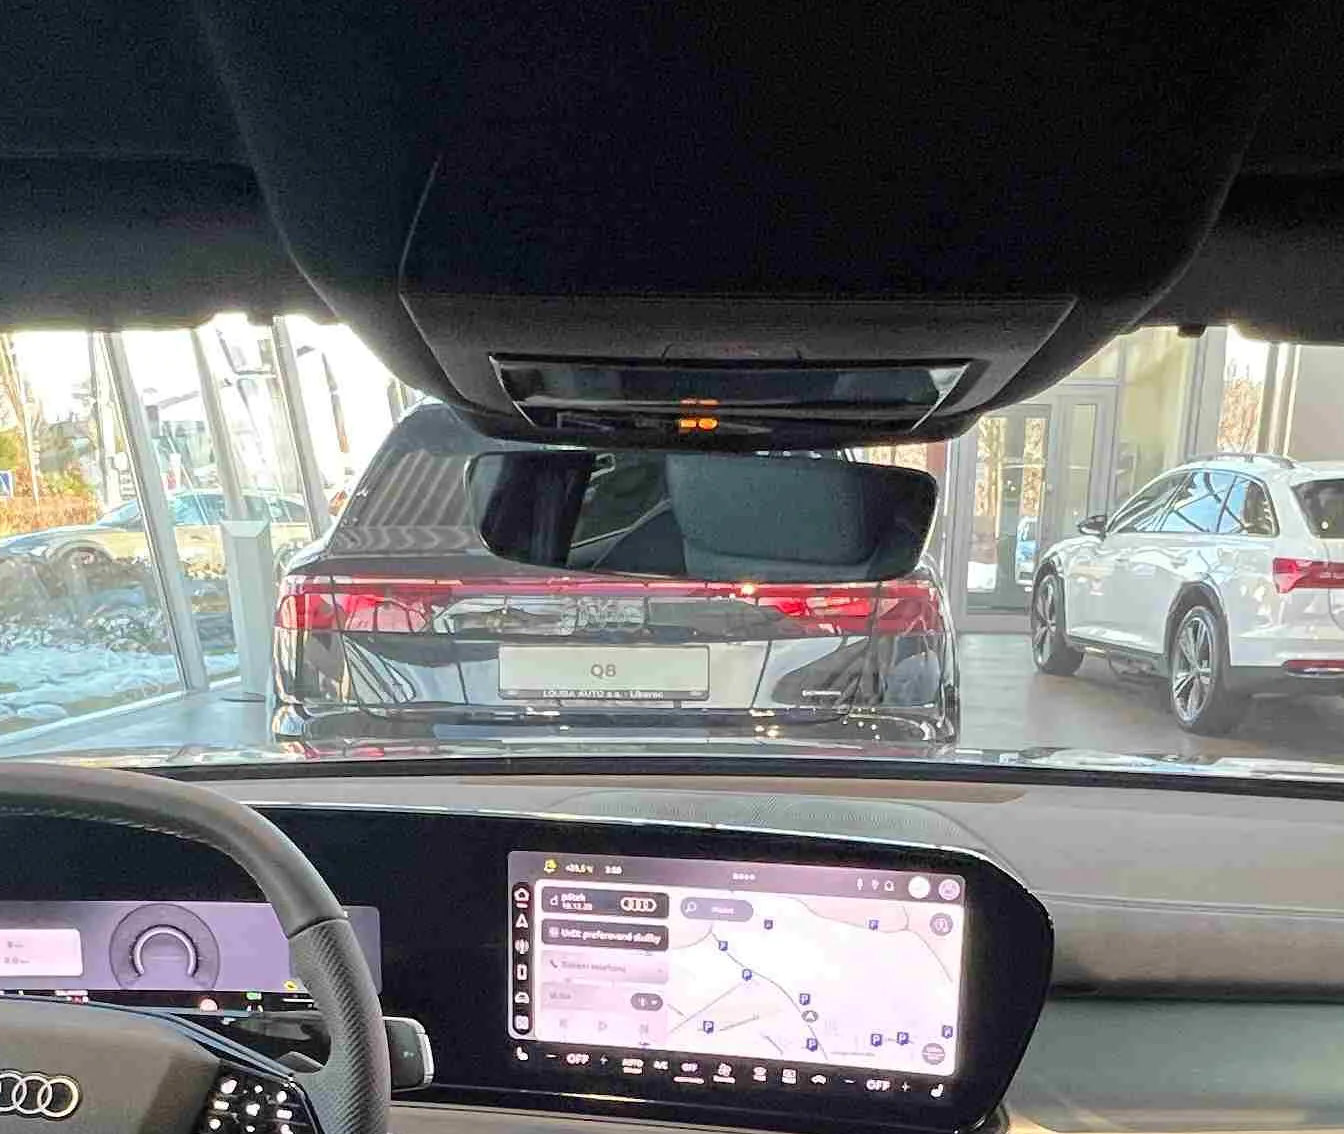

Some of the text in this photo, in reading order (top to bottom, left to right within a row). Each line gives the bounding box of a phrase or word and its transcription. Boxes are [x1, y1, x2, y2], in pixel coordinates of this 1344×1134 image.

[590, 663, 617, 679] Q8
[566, 1053, 590, 1065] OFF
[866, 1079, 891, 1091] OFF
